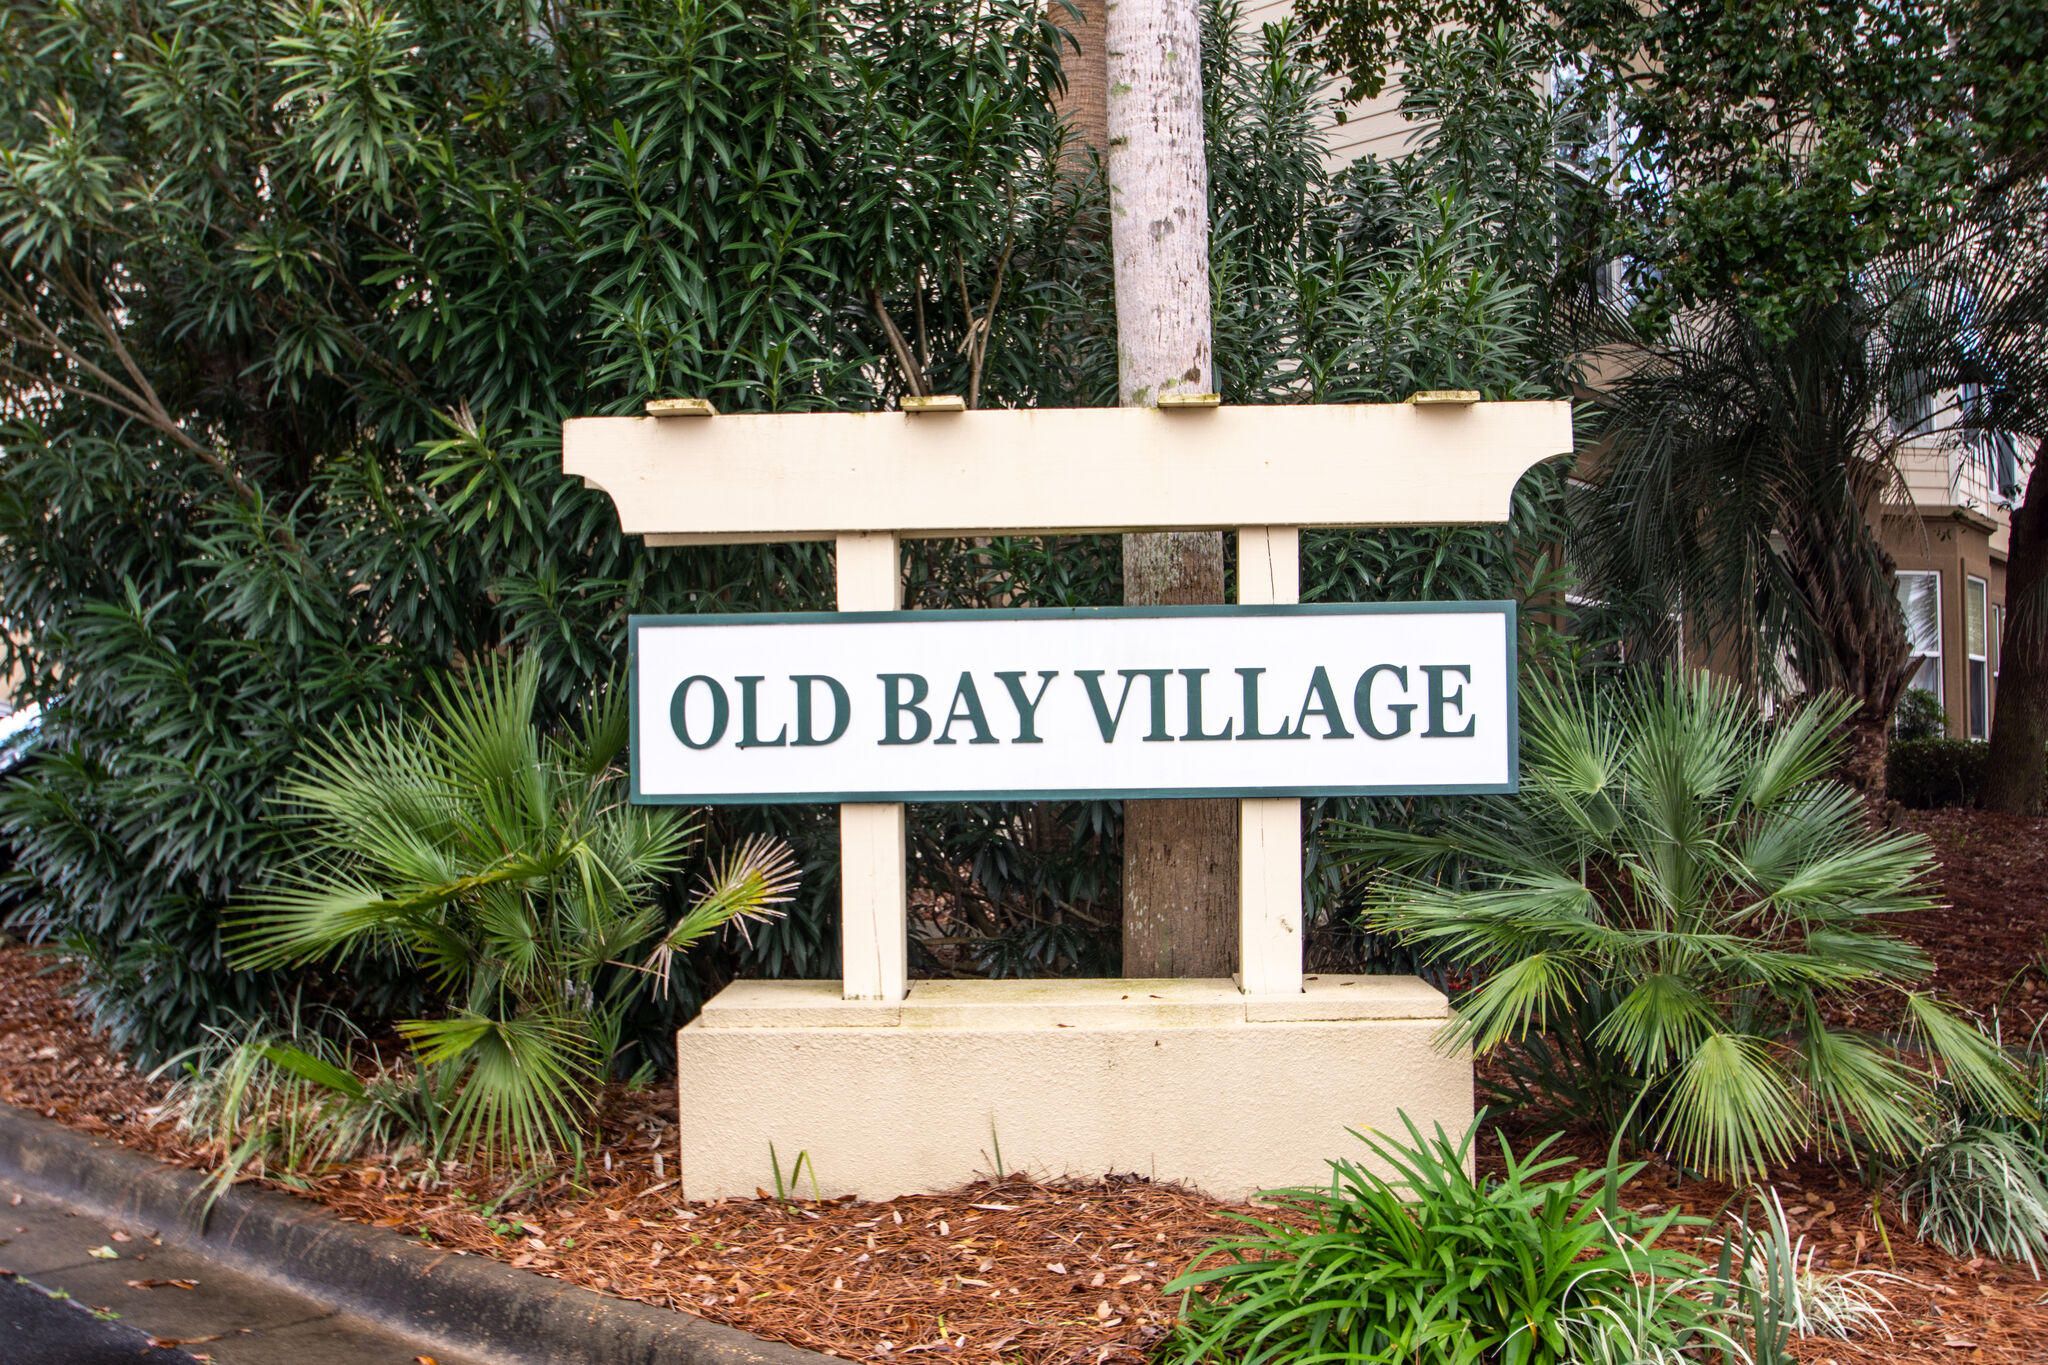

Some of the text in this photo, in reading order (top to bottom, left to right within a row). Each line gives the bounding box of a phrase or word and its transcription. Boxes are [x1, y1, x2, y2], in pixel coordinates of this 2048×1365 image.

[669, 664, 1475, 750] OLD BAY VILLAGE
